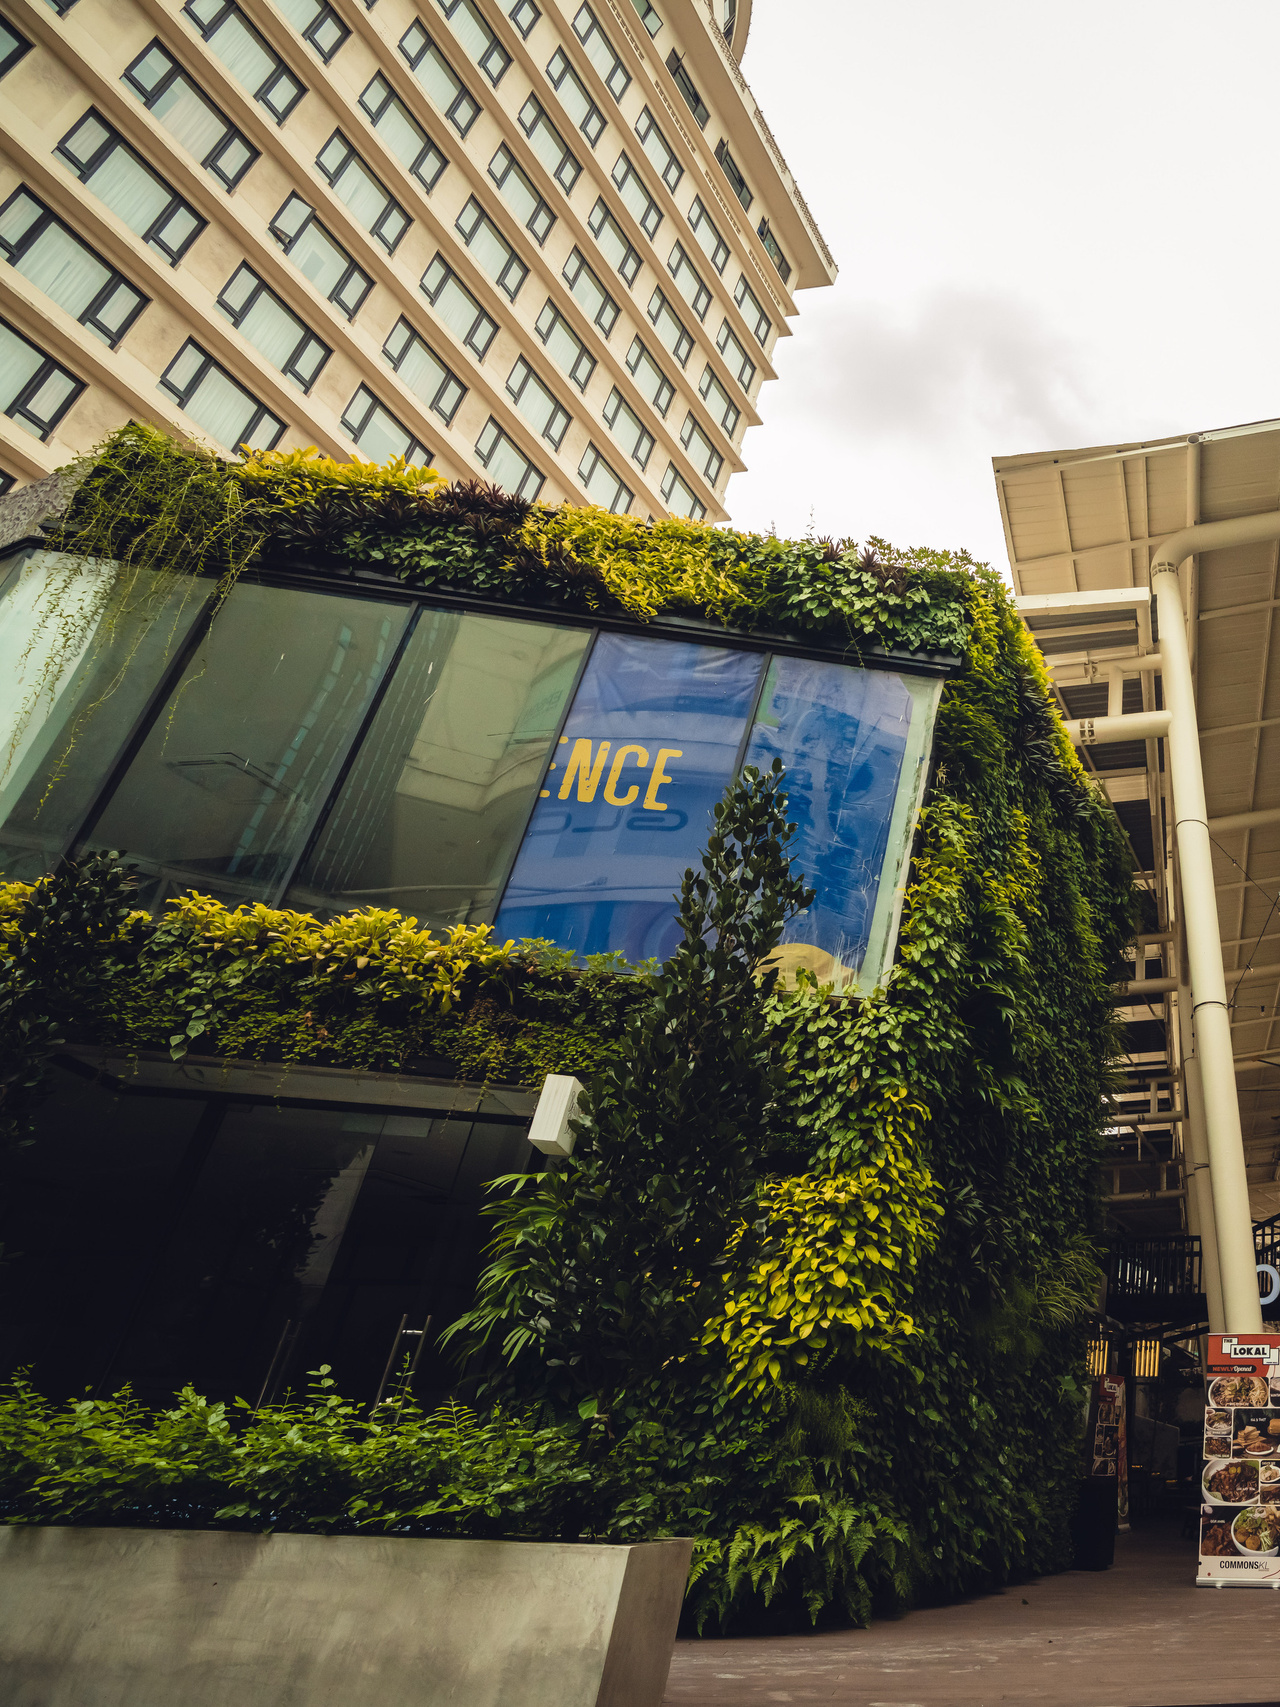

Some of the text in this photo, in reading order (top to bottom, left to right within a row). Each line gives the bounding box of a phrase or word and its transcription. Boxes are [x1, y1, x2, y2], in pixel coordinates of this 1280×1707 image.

[538, 736, 683, 811] NCE
[1233, 1347, 1267, 1356] LOKAL
[1233, 1365, 1253, 1373] Opened
